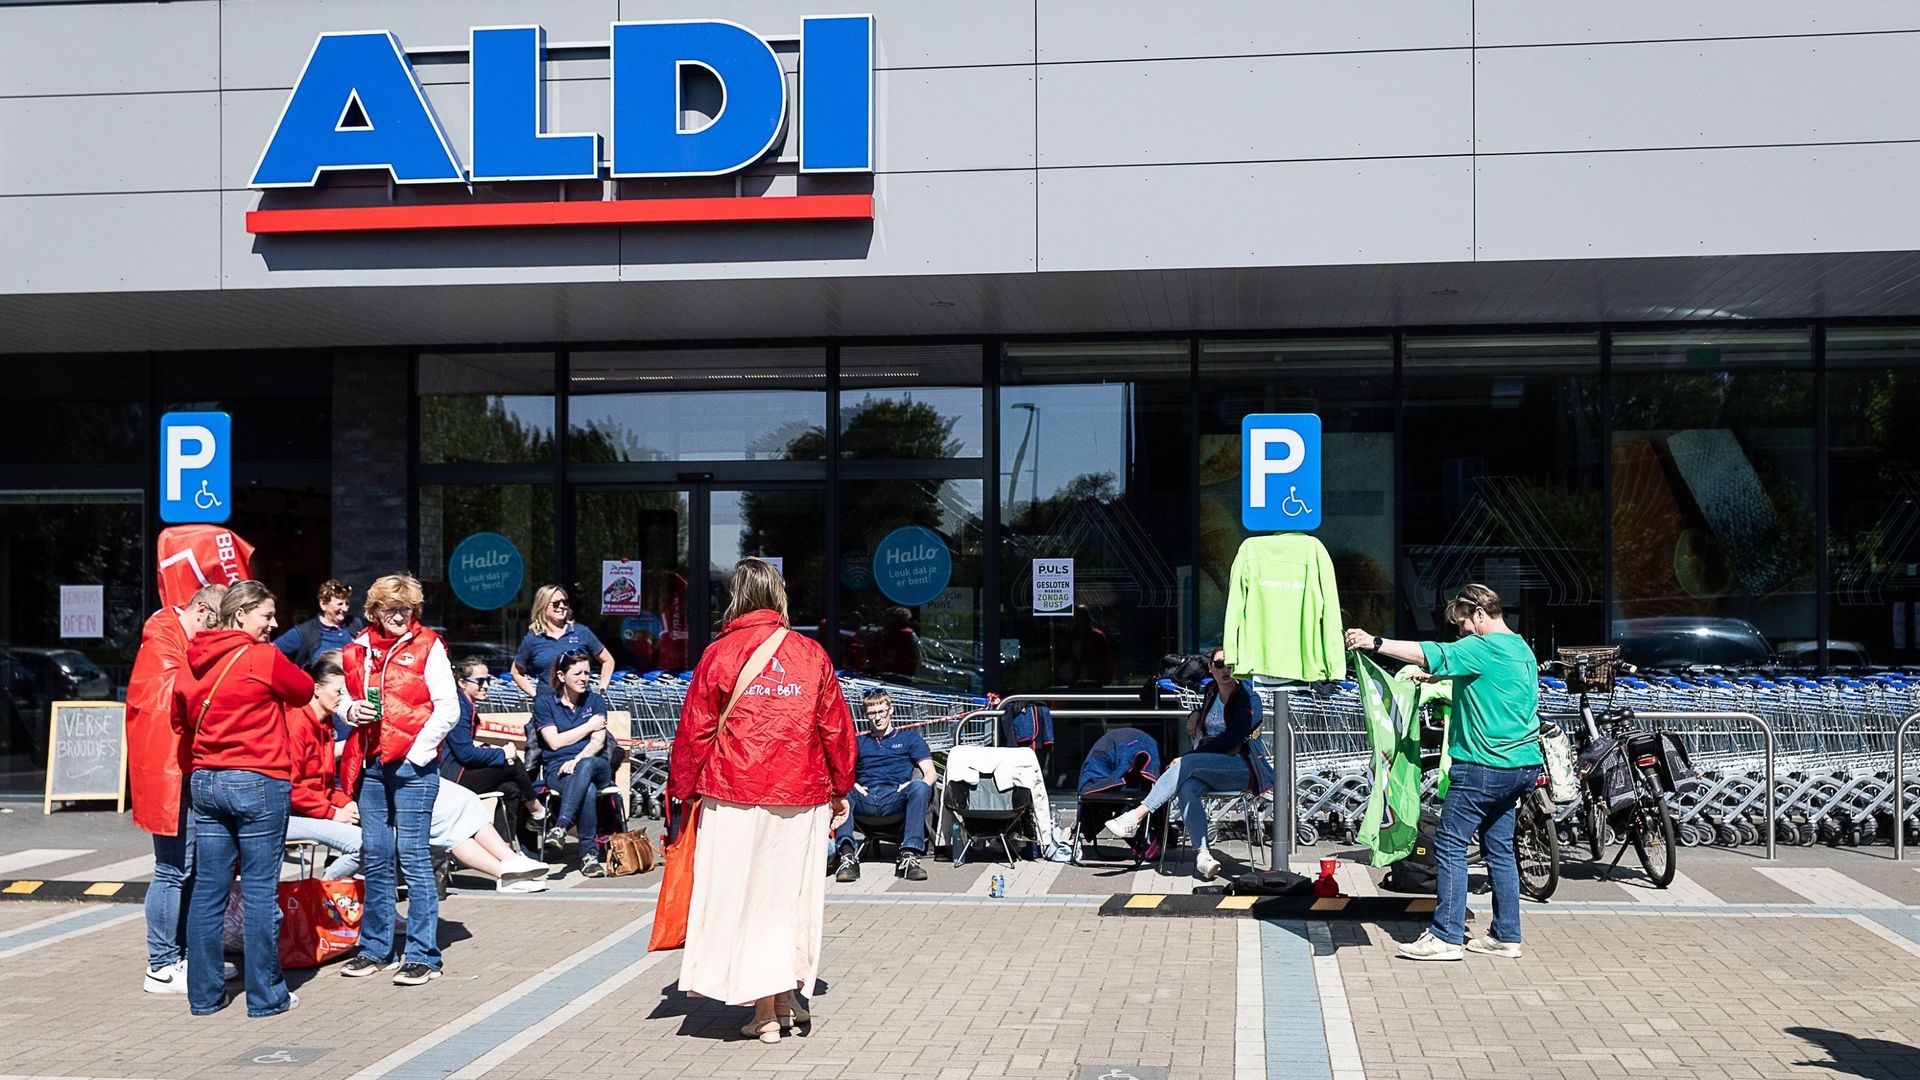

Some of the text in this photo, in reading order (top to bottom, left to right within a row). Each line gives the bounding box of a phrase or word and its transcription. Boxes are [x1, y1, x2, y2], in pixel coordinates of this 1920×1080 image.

[247, 14, 874, 188] ALDI
[167, 425, 216, 501] P
[1250, 428, 1305, 508] P
[215, 532, 240, 586] BBTK
[461, 549, 512, 570] Hallo
[886, 544, 939, 565] Hallo
[463, 573, 485, 583] Leuk
[888, 566, 937, 579] Leuk dat je
[907, 574, 932, 585] bent!
[1036, 581, 1070, 589] GESLOTEN
[63, 614, 97, 633] OPEN
[63, 712, 113, 737] VERSE
